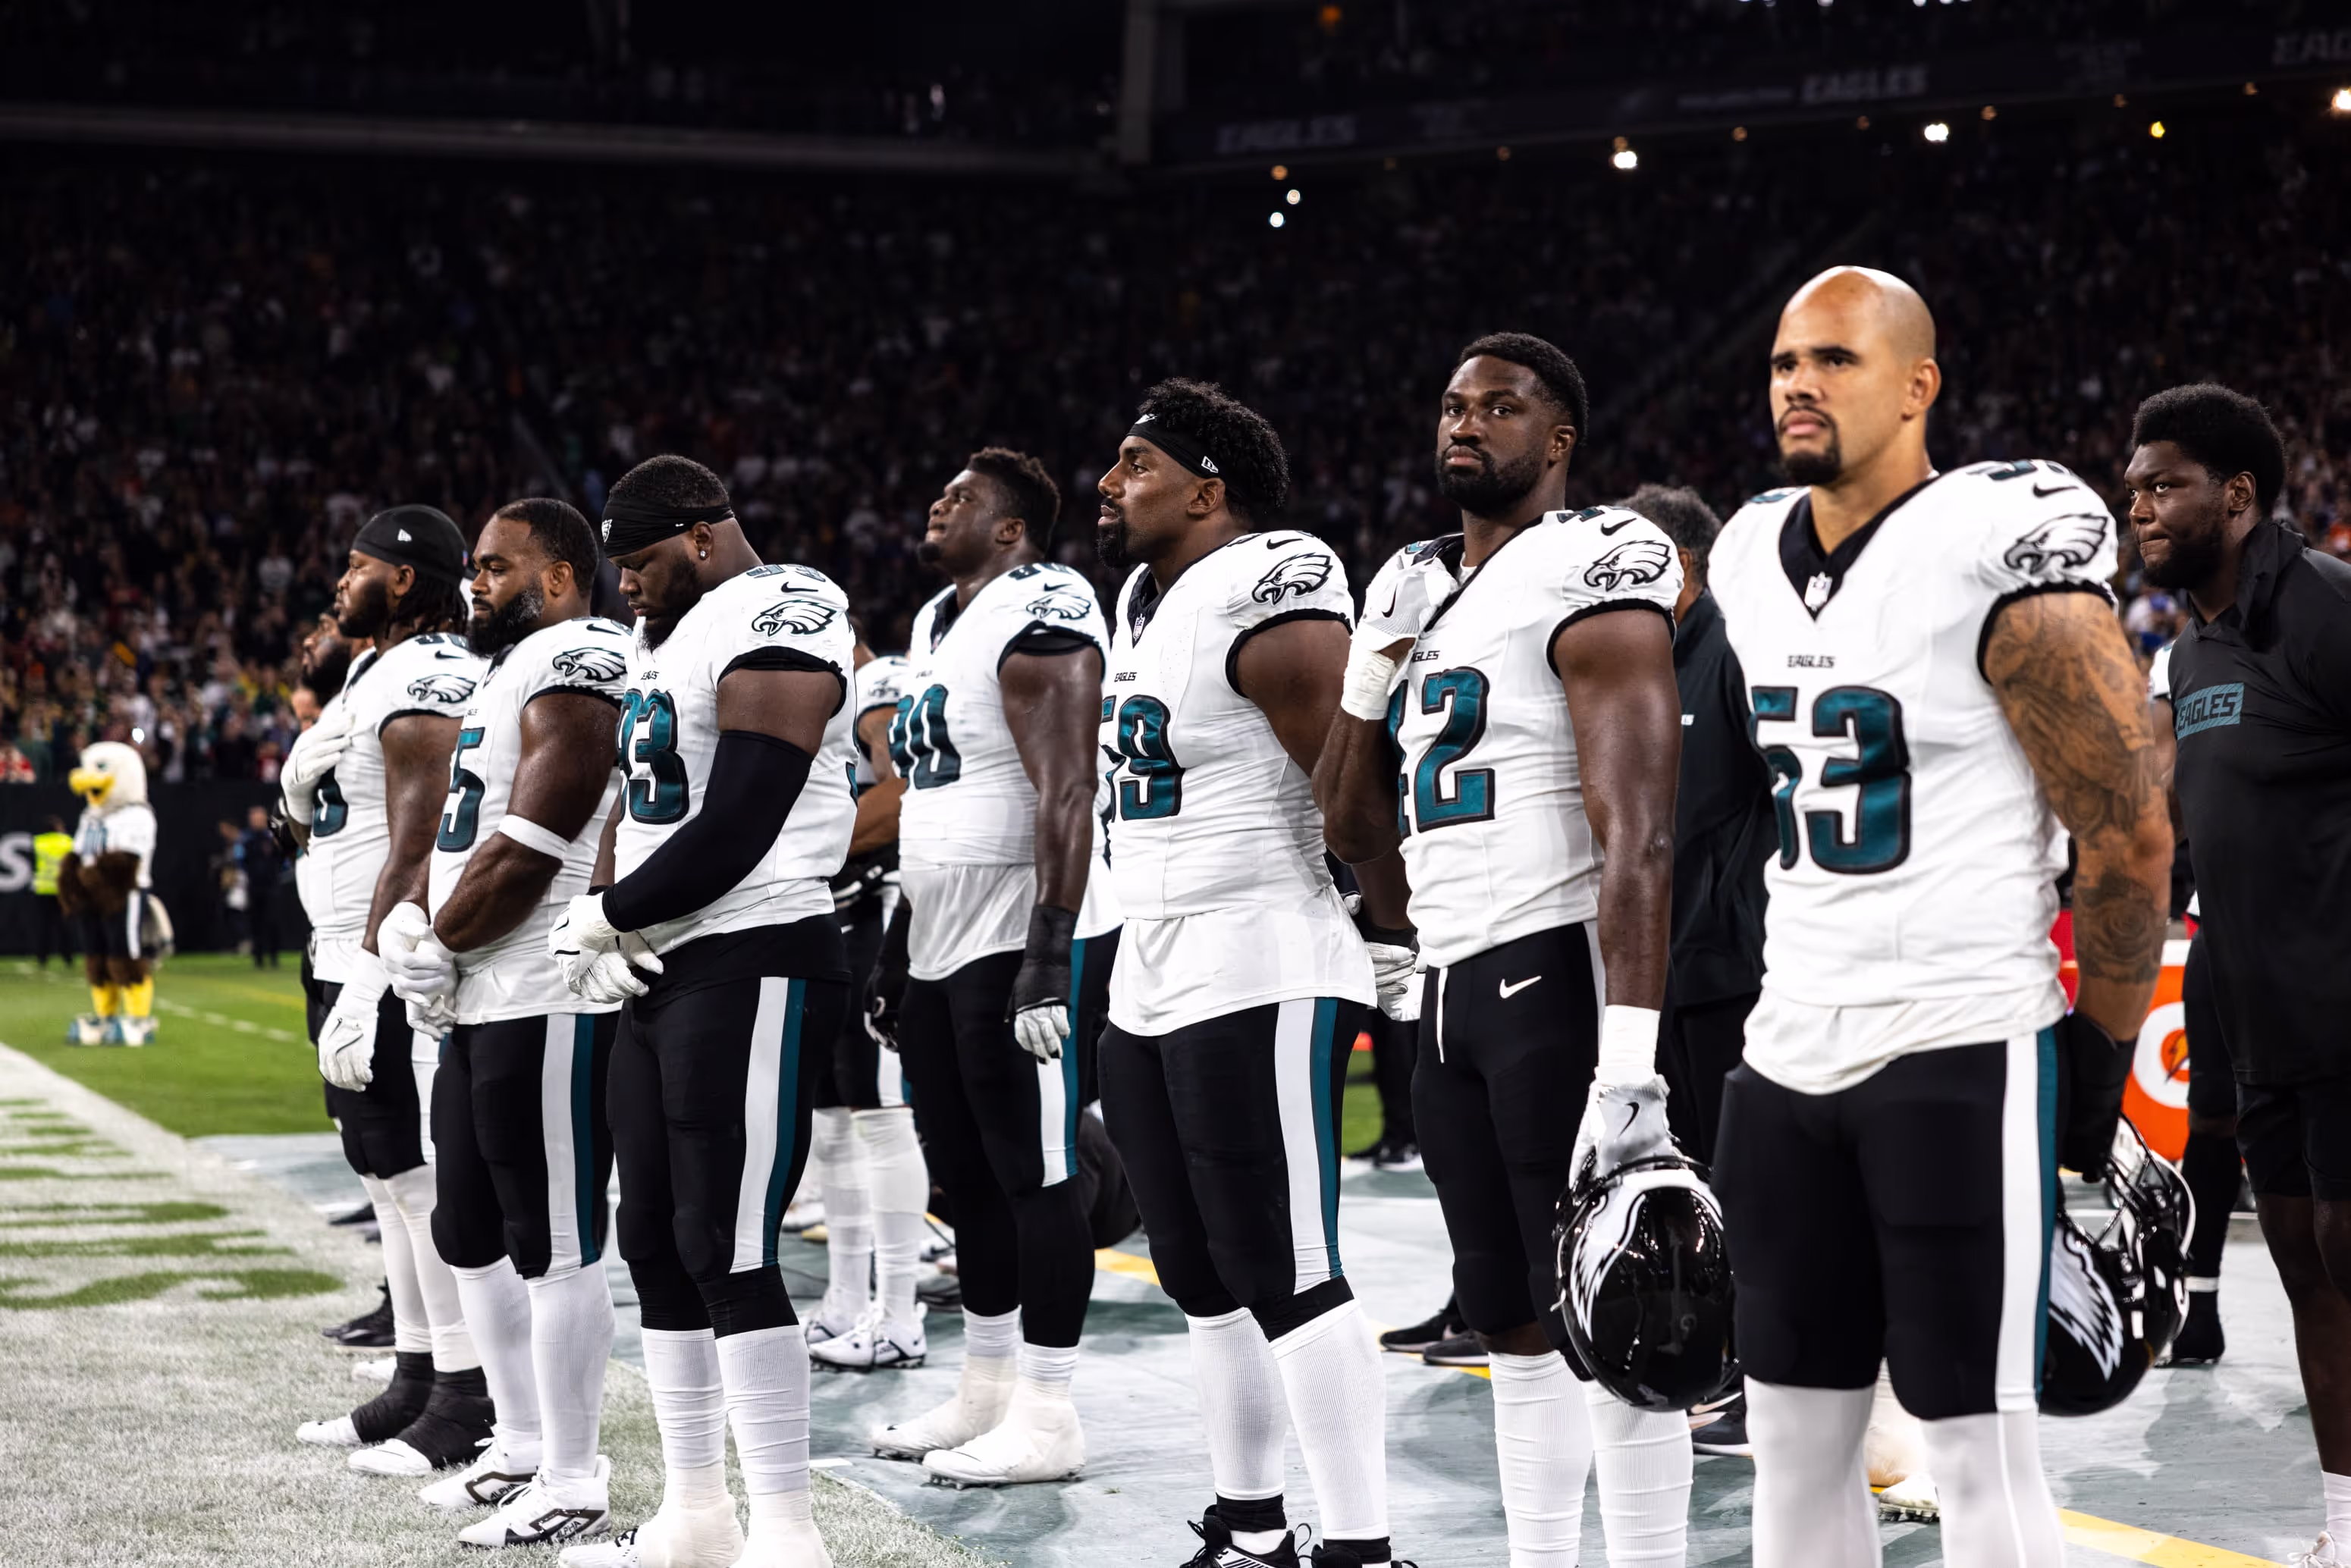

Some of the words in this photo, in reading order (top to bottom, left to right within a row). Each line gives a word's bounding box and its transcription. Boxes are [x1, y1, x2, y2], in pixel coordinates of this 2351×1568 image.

[1787, 655, 1835, 668] EAGLES
[1114, 672, 1138, 682] EAGLES
[2177, 691, 2239, 731] EAGLES
[1747, 685, 1911, 874] 53
[556, 1520, 582, 1538] ALPHA
